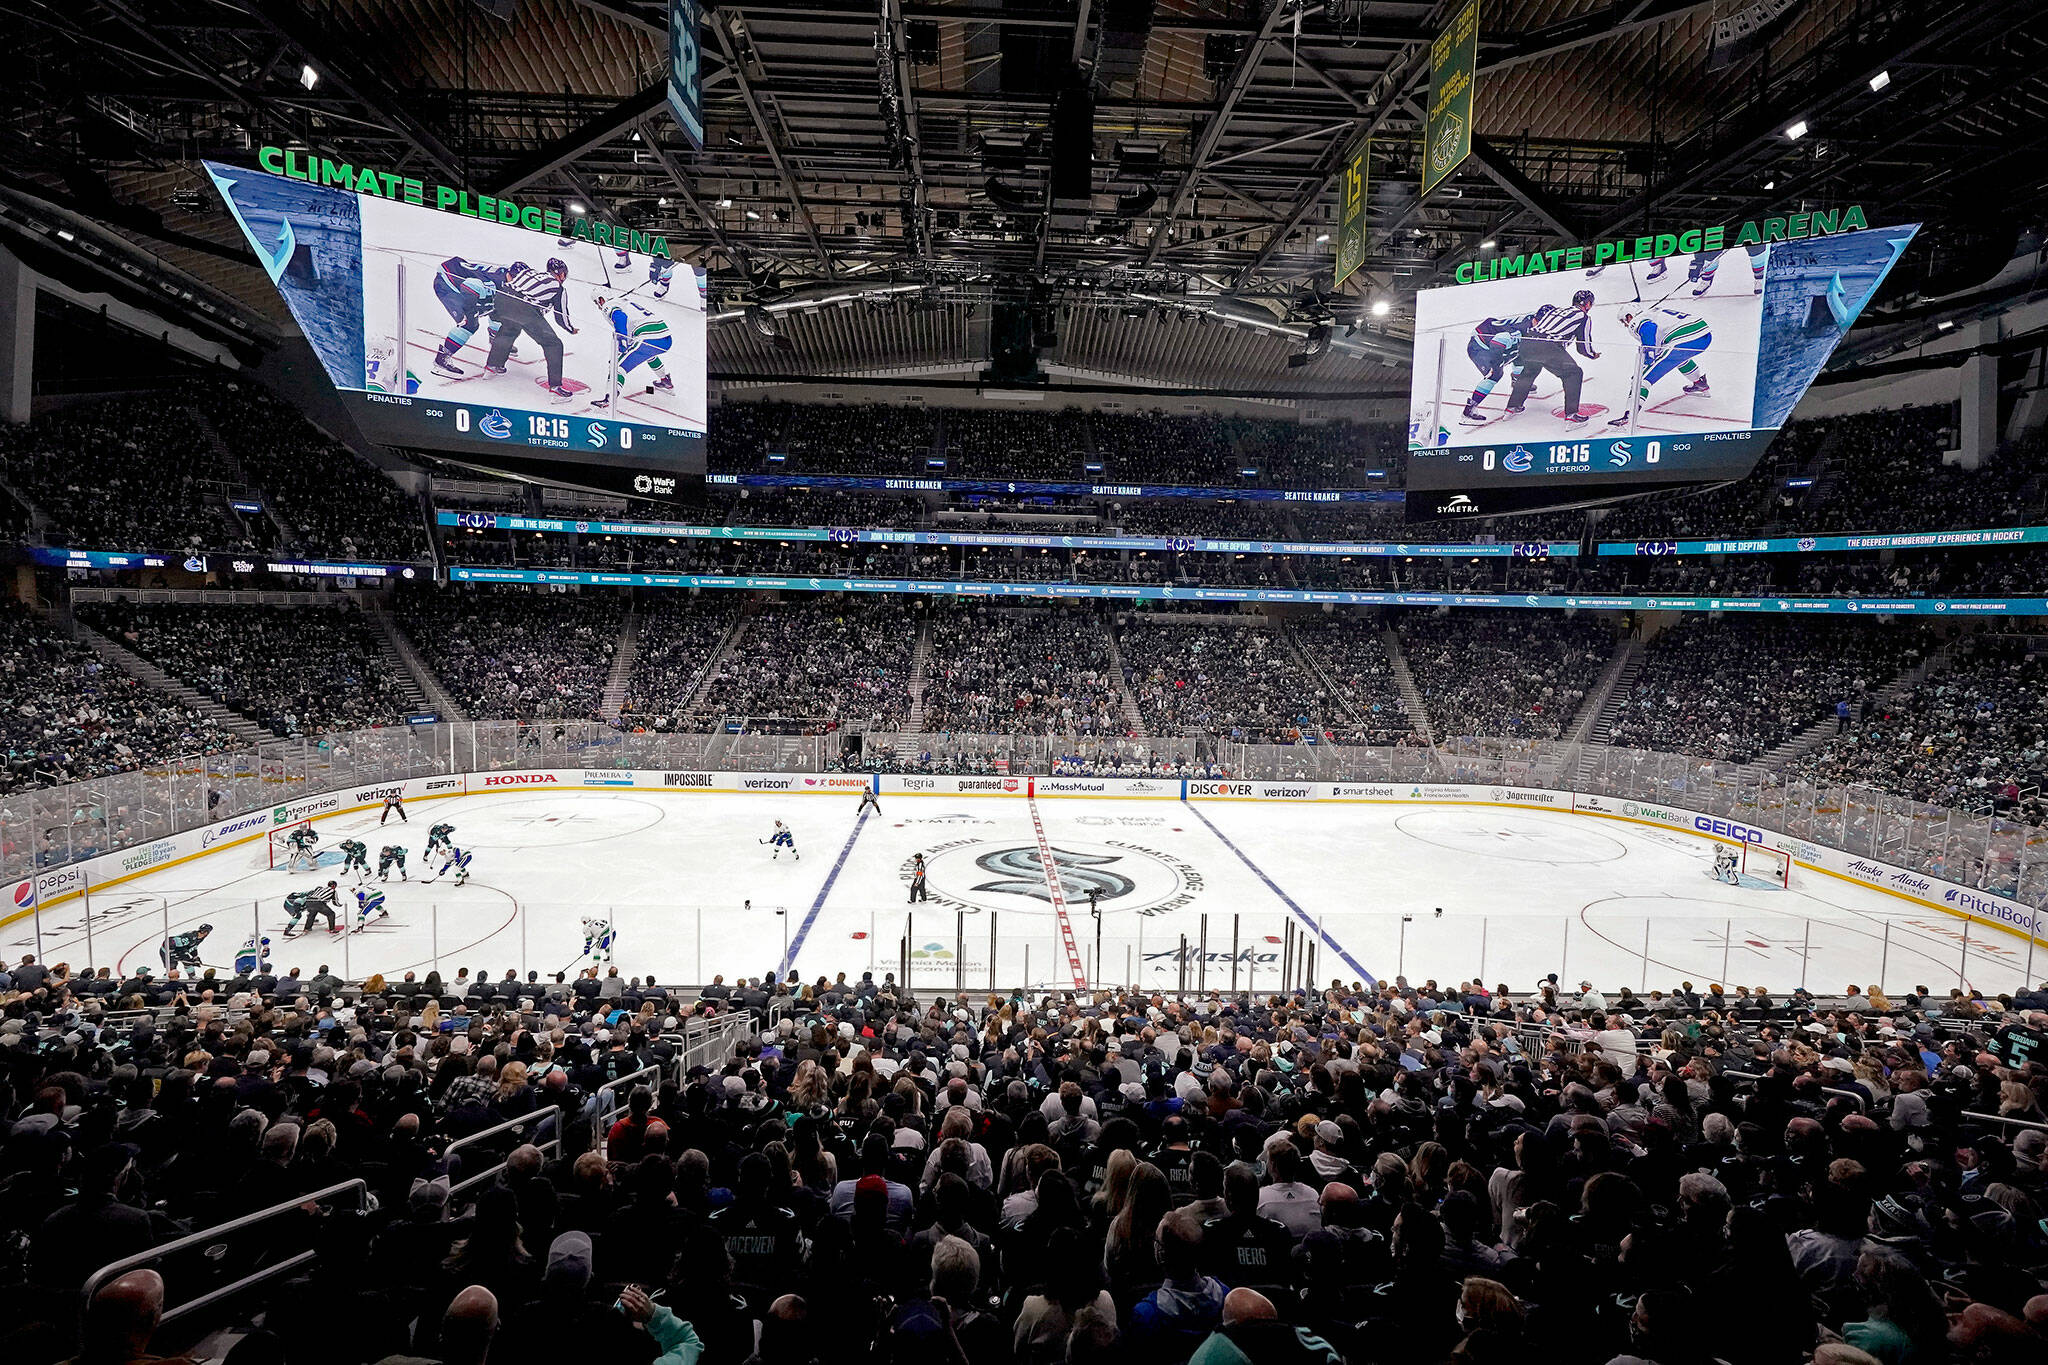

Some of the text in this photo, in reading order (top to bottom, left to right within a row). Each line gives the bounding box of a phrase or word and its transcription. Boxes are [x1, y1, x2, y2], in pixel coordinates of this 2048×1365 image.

[1440, 69, 1460, 98] WNBA
[1430, 72, 1470, 122] CHAMPIONS
[1346, 155, 1362, 208] 15
[258, 146, 671, 260] CLIMATE PLEDGE ARENA
[1455, 246, 1583, 284] CLIMATE
[1595, 226, 1725, 266] PLEDGE
[1735, 205, 1868, 247] ARENA
[367, 394, 412, 406] PENALTIES
[426, 409, 443, 418] SOG
[456, 408, 470, 432] 0
[528, 416, 569, 438] 18:15
[620, 427, 632, 449] 0
[668, 429, 702, 439] PENALTIES
[1704, 432, 1751, 441] PENALTIES
[543, 439, 568, 448] PERIOD
[1413, 448, 1450, 457] PENALTIES
[1549, 444, 1590, 464] 18:15
[1647, 441, 1660, 463] 0
[1483, 450, 1495, 470] 0
[1561, 464, 1590, 472] PERIOD
[653, 477, 675, 487] WaFd
[713, 475, 737, 484] KRAKEN
[886, 479, 942, 490] SEATTLE KRAKEN
[654, 486, 673, 495] Bank
[1092, 486, 1141, 495] SEATTLE KRAKEN
[1284, 492, 1340, 501] SEATTLE KRAKEN
[1437, 505, 1479, 514] SYMETRA
[510, 519, 563, 530] JOIN THE DEPTHS
[1862, 538, 1890, 546] DEEPEST
[1892, 536, 1936, 545] MEMBERSHIP
[1938, 533, 1981, 543] EXPERIENCE
[1982, 532, 1991, 541] IN
[1992, 531, 2024, 540] HOCKEY
[1704, 541, 1768, 552] JOIN THE DEPTHS
[267, 564, 386, 576] THANK YOU FOUNDING PARTNERS
[485, 774, 558, 786] HONDA
[664, 774, 712, 786] IMPOSSIBLE
[744, 778, 788, 788] verizon
[829, 779, 869, 787] DUNKIN'
[902, 778, 935, 791] Tegria
[958, 779, 1002, 791] guaranteed
[1004, 780, 1018, 789] Rate
[1051, 783, 1104, 792] MassMutual
[1191, 784, 1252, 795] DISCOVER
[1264, 787, 1306, 798] verizon
[1343, 787, 1393, 796] smartsheet
[277, 798, 337, 820] enterprise
[1640, 808, 1690, 824] WaFd Bank
[219, 815, 267, 836] BOEING
[1695, 816, 1762, 843] GEICO
[159, 846, 176, 856] years
[926, 837, 984, 854] ARENA
[1105, 840, 1181, 862] CLIMATE
[1175, 864, 1204, 891] PLEDGE
[1848, 860, 1883, 877] Alaska
[39, 866, 80, 893] pepsi
[1849, 870, 1879, 883] AIRLINES
[1890, 873, 1930, 890] Alaska
[44, 884, 74, 898] ZERO SUGAR
[1892, 883, 1925, 897] AIRLINES
[1142, 948, 1278, 963] Alaska
[2007, 1031, 2039, 1048] GIORDANO
[2008, 1042, 2030, 1069] 5
[1237, 1247, 1267, 1265] BERG
